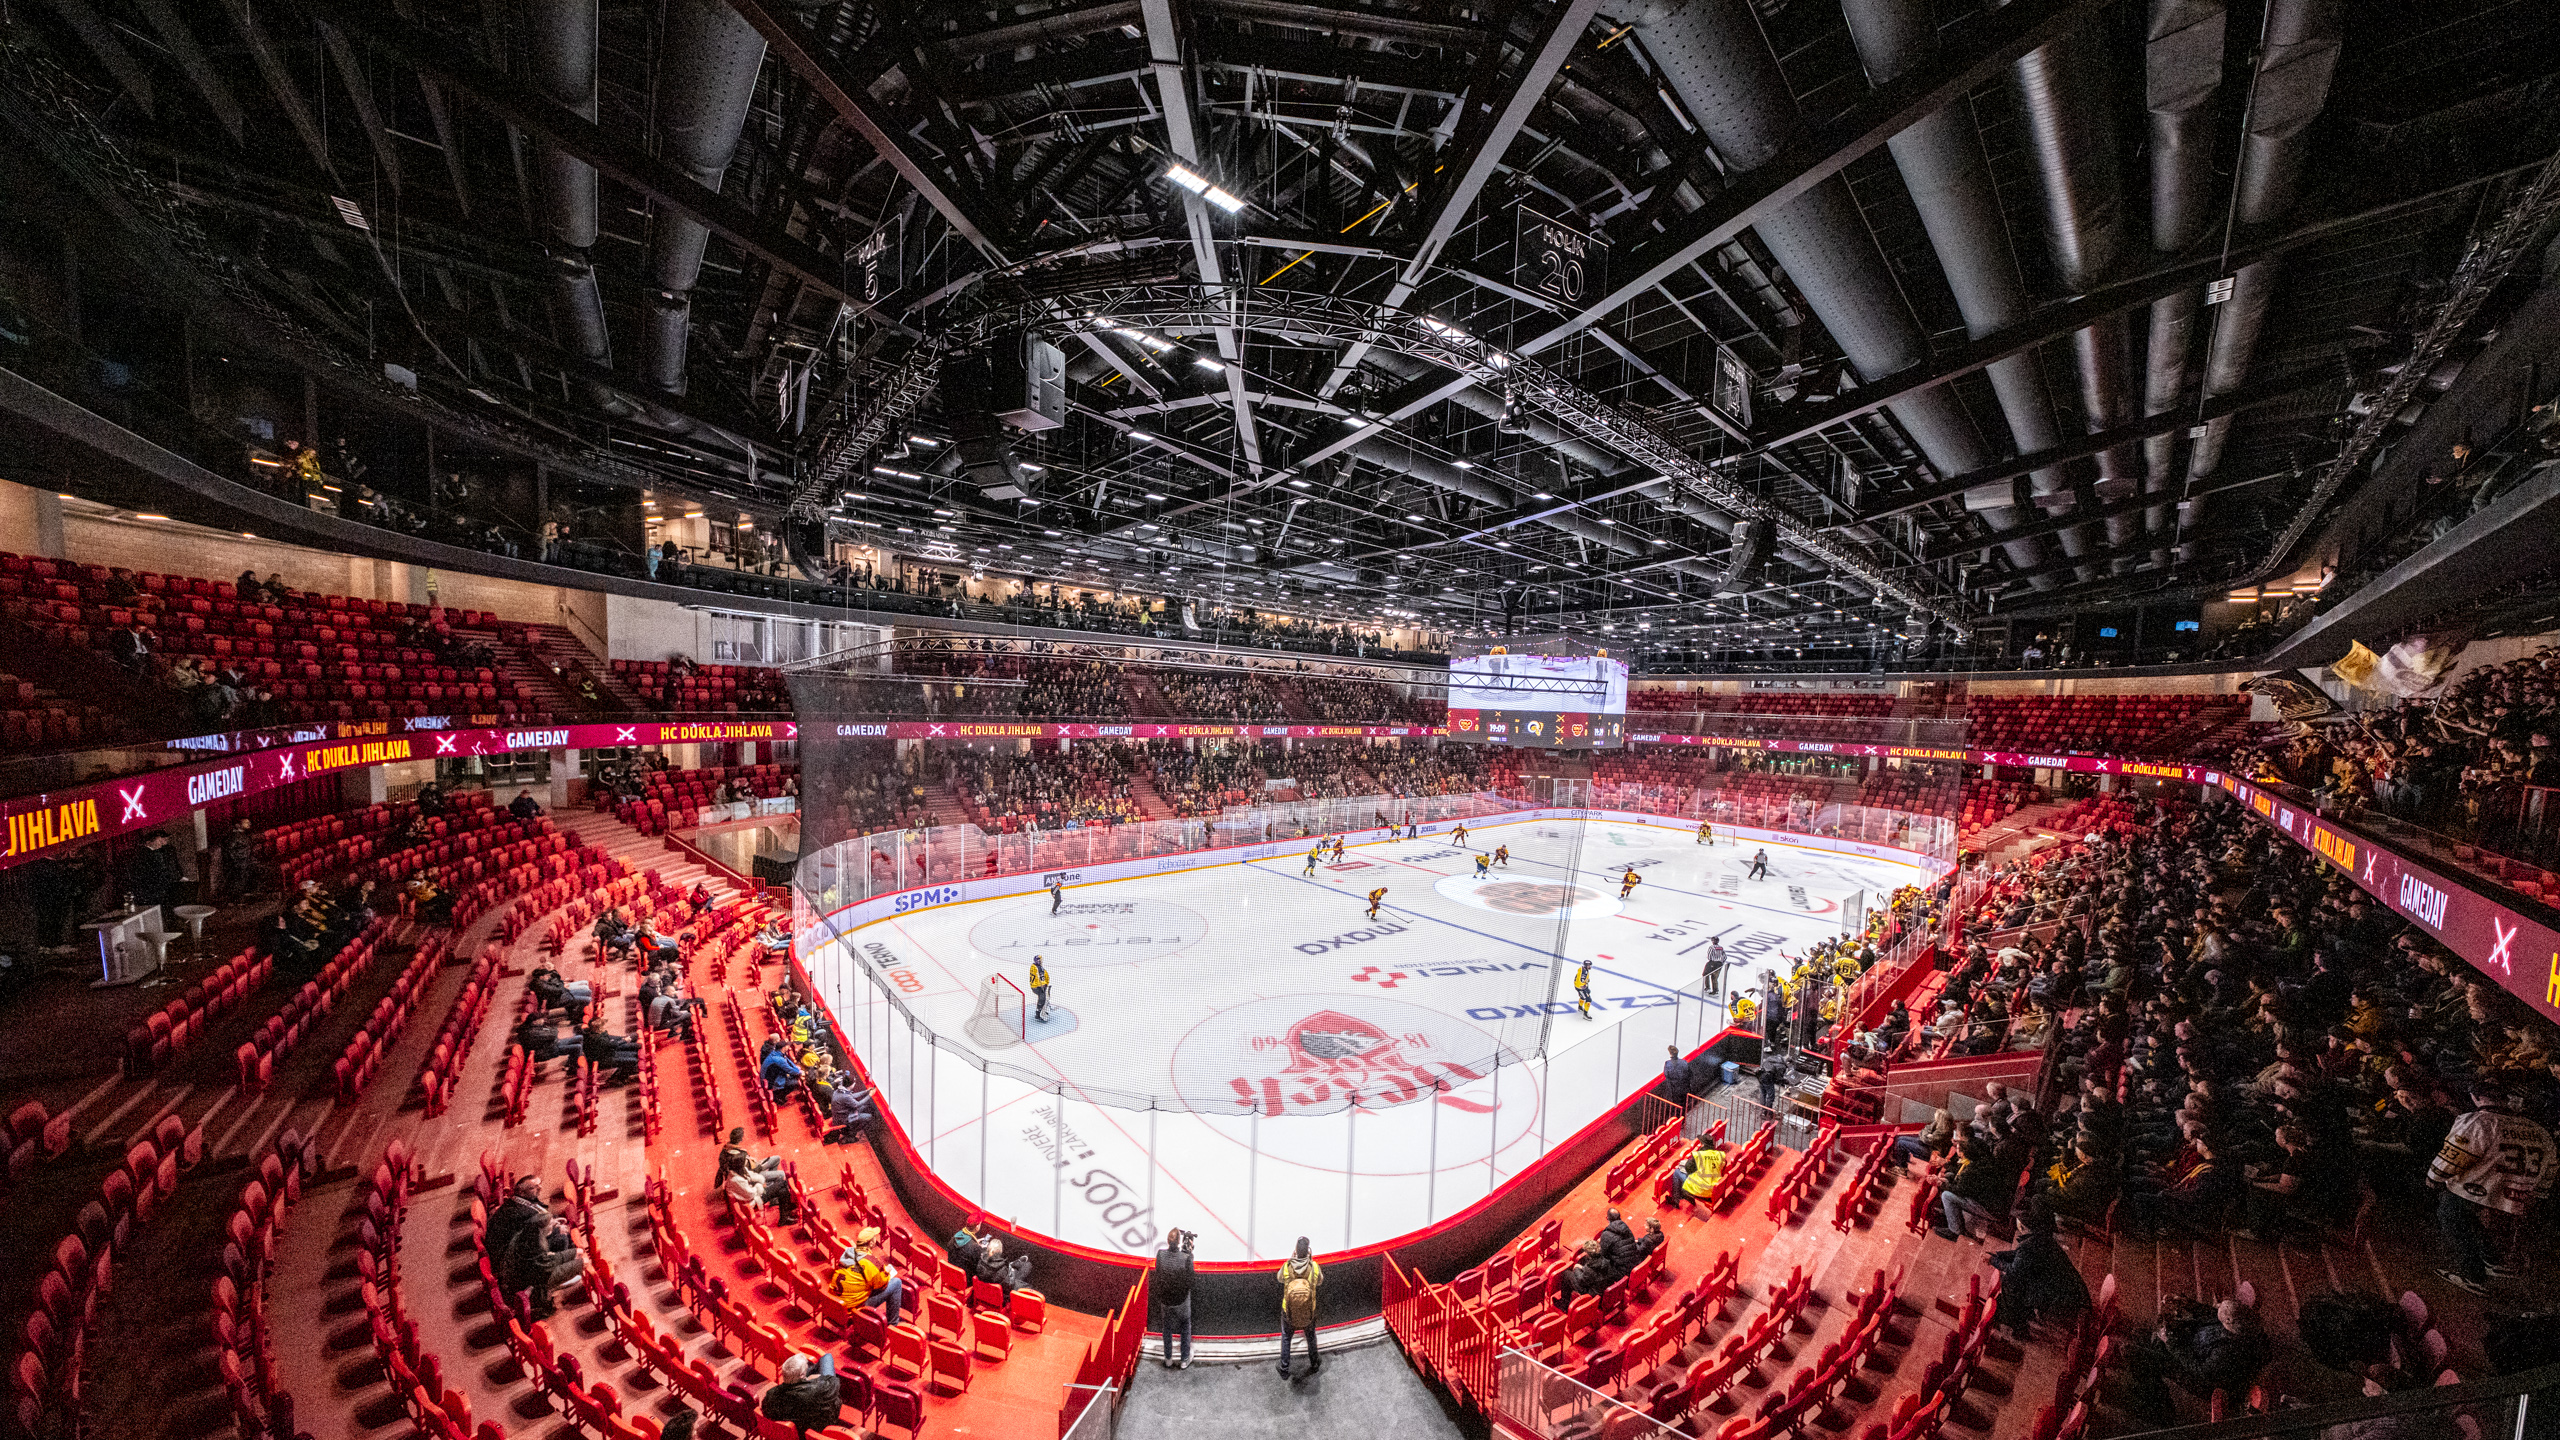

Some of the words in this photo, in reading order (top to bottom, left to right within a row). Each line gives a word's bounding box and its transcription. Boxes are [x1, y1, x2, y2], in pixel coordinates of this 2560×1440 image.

[865, 260, 878, 300] 5
[1539, 250, 1584, 301] 20
[506, 729, 569, 748] GAMEDAY
[660, 726, 676, 740] HC
[680, 726, 721, 740] DUKLA
[724, 724, 773, 739] JIHLAVA
[837, 724, 888, 736] GAMEDAY
[960, 725, 974, 736] HC
[976, 725, 1005, 736] DUKLA
[1007, 725, 1042, 736] JIHLAVA
[1099, 726, 1133, 736] GAMEDAY
[1179, 726, 1188, 735] HC
[1188, 726, 1208, 735] DUKLA
[1209, 726, 1234, 735] JIHLAVA
[1263, 727, 1287, 736] GAMEDAY
[1632, 733, 1661, 743] GAMEDAY
[1702, 737, 1710, 745] HC
[1712, 737, 1733, 747] DUKLA
[1734, 738, 1760, 748] JIHLAVA
[1799, 742, 1834, 752] GAMEDAY
[307, 751, 321, 772] HC
[323, 745, 359, 769] DUKLA
[362, 739, 411, 763] JIHLAVA
[1890, 747, 1901, 757] HC
[1903, 747, 1931, 759] DUKLA
[1932, 748, 1966, 760] JIHLAVA
[2028, 755, 2068, 768] GAMEDAY
[2122, 762, 2132, 773] HC
[2133, 763, 2156, 776] DUKLA
[2157, 765, 2182, 778] JIHLAVA
[188, 766, 243, 805] GAMEDAY
[7, 799, 99, 857] JIHLAVA
[894, 888, 941, 912] SPM
[2400, 873, 2448, 930] GAMEDAY
[1645, 919, 1709, 942] LIGA
[863, 942, 902, 969] TERNO
[1416, 962, 1549, 978] VINCI
[889, 967, 925, 993] coop
[1466, 1000, 1607, 1022] LOKO
[1251, 1035, 1278, 1052] 60
[1402, 1032, 1432, 1050] 18
